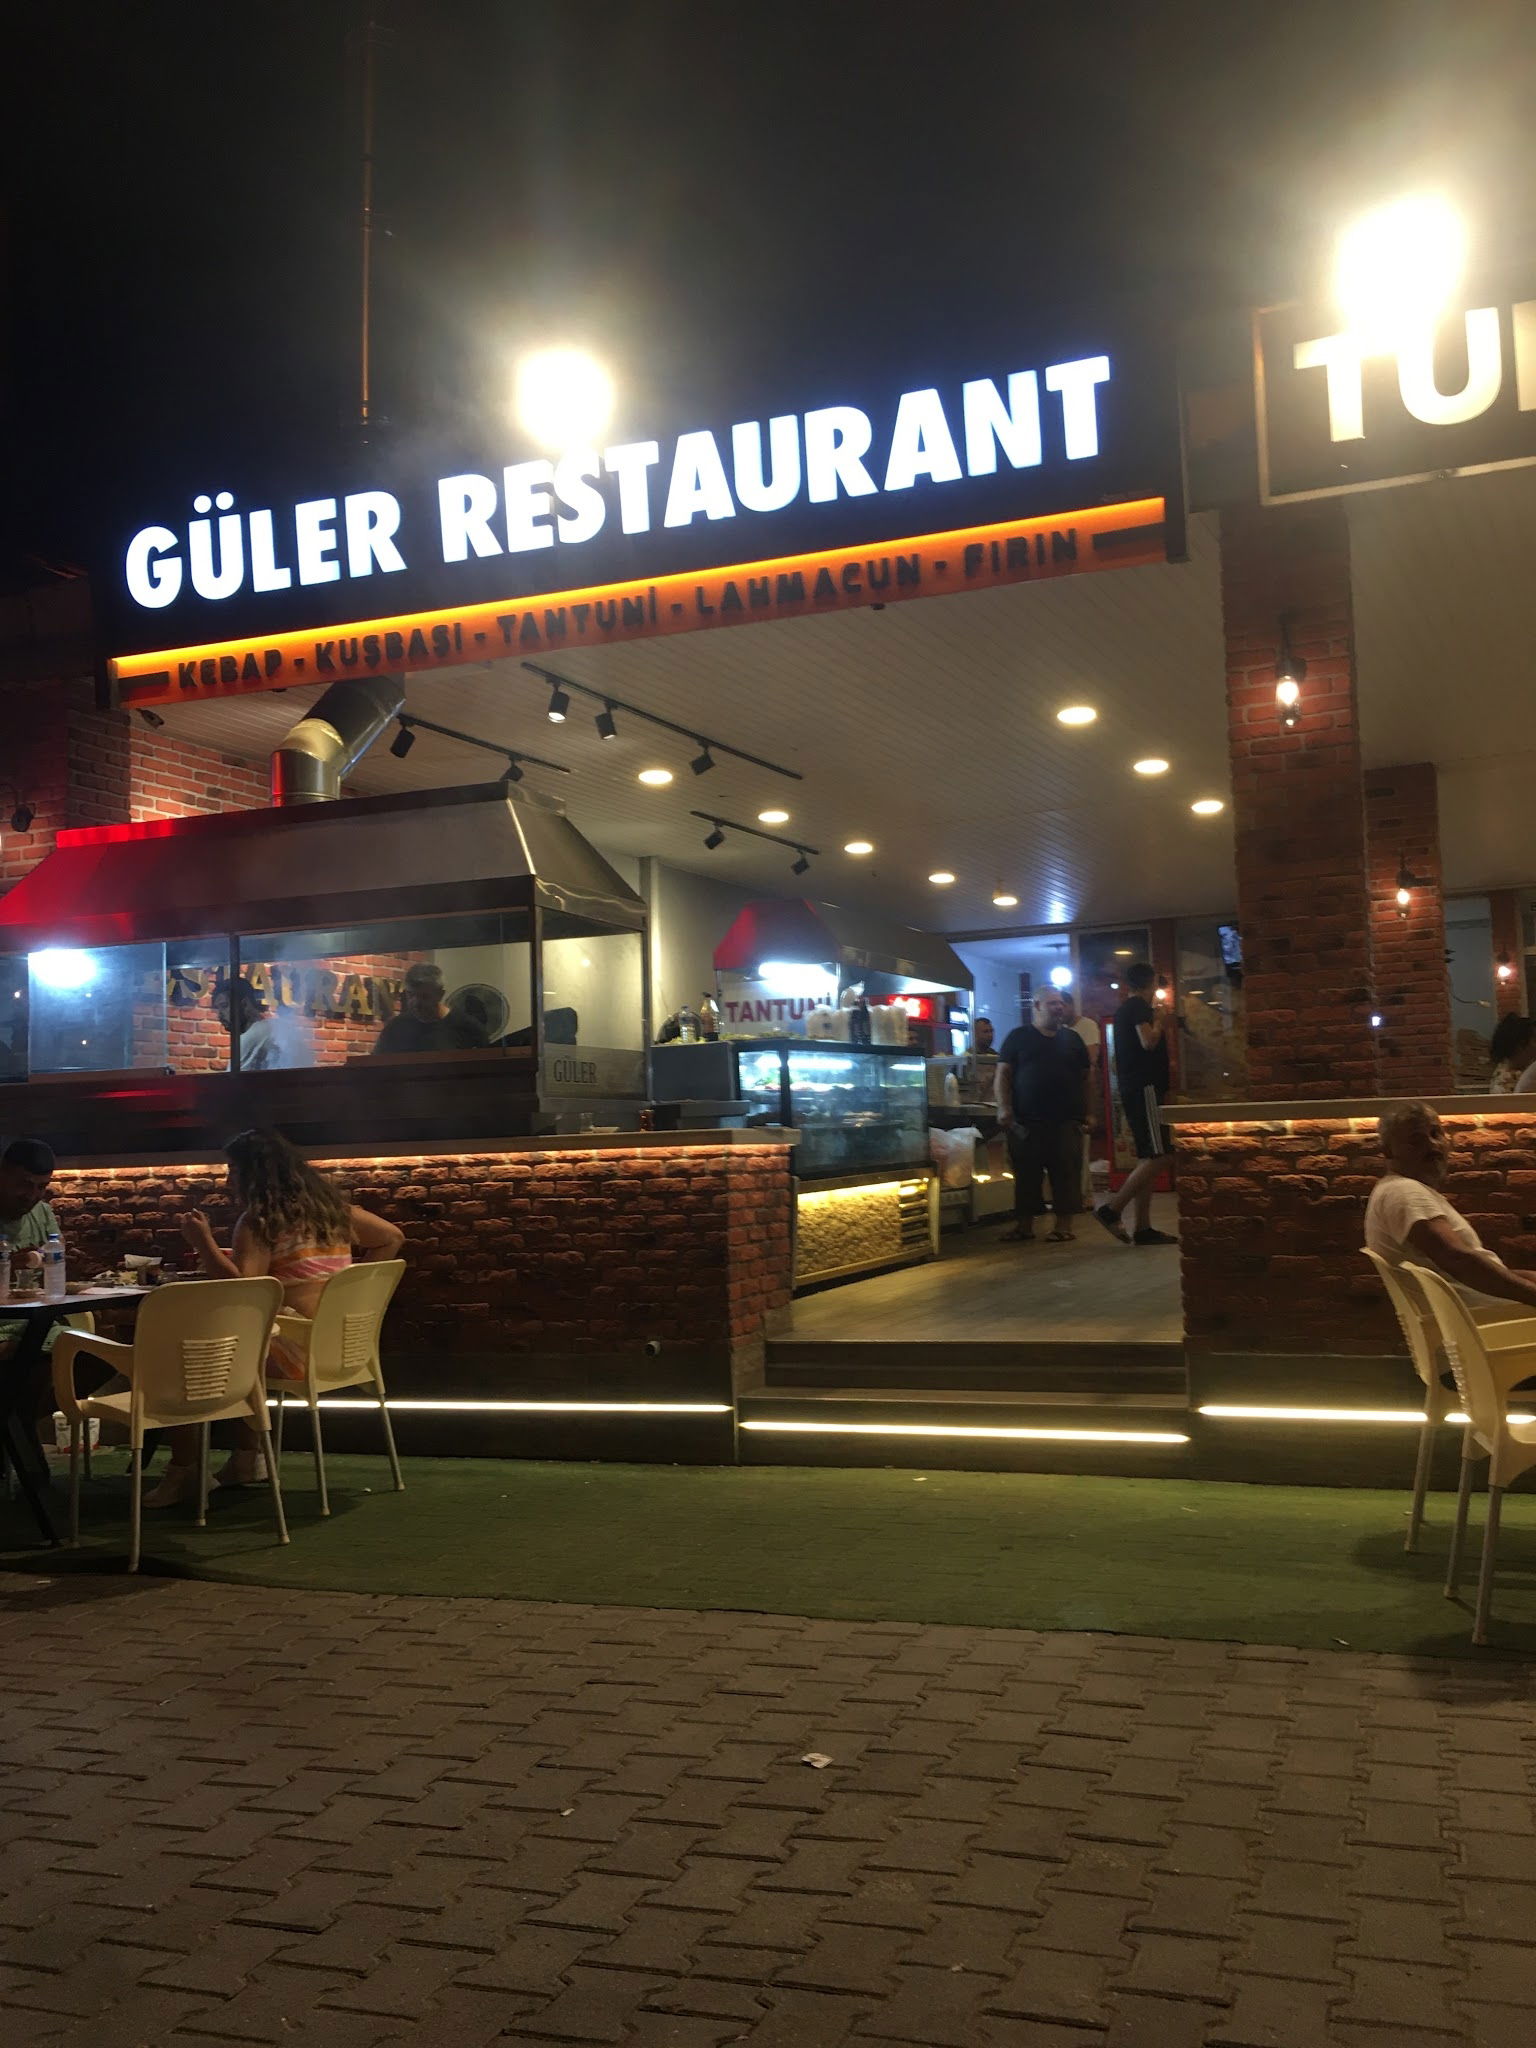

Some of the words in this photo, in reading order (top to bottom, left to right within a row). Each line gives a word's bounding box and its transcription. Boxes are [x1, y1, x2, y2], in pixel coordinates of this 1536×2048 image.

[125, 491, 407, 609] GÜLER
[437, 355, 1110, 563] RESTAURANT
[178, 649, 282, 689] KEBAP
[695, 553, 920, 615] LAHMACUN
[963, 528, 1077, 578] FIRIN
[553, 1055, 598, 1084] GÜLER
